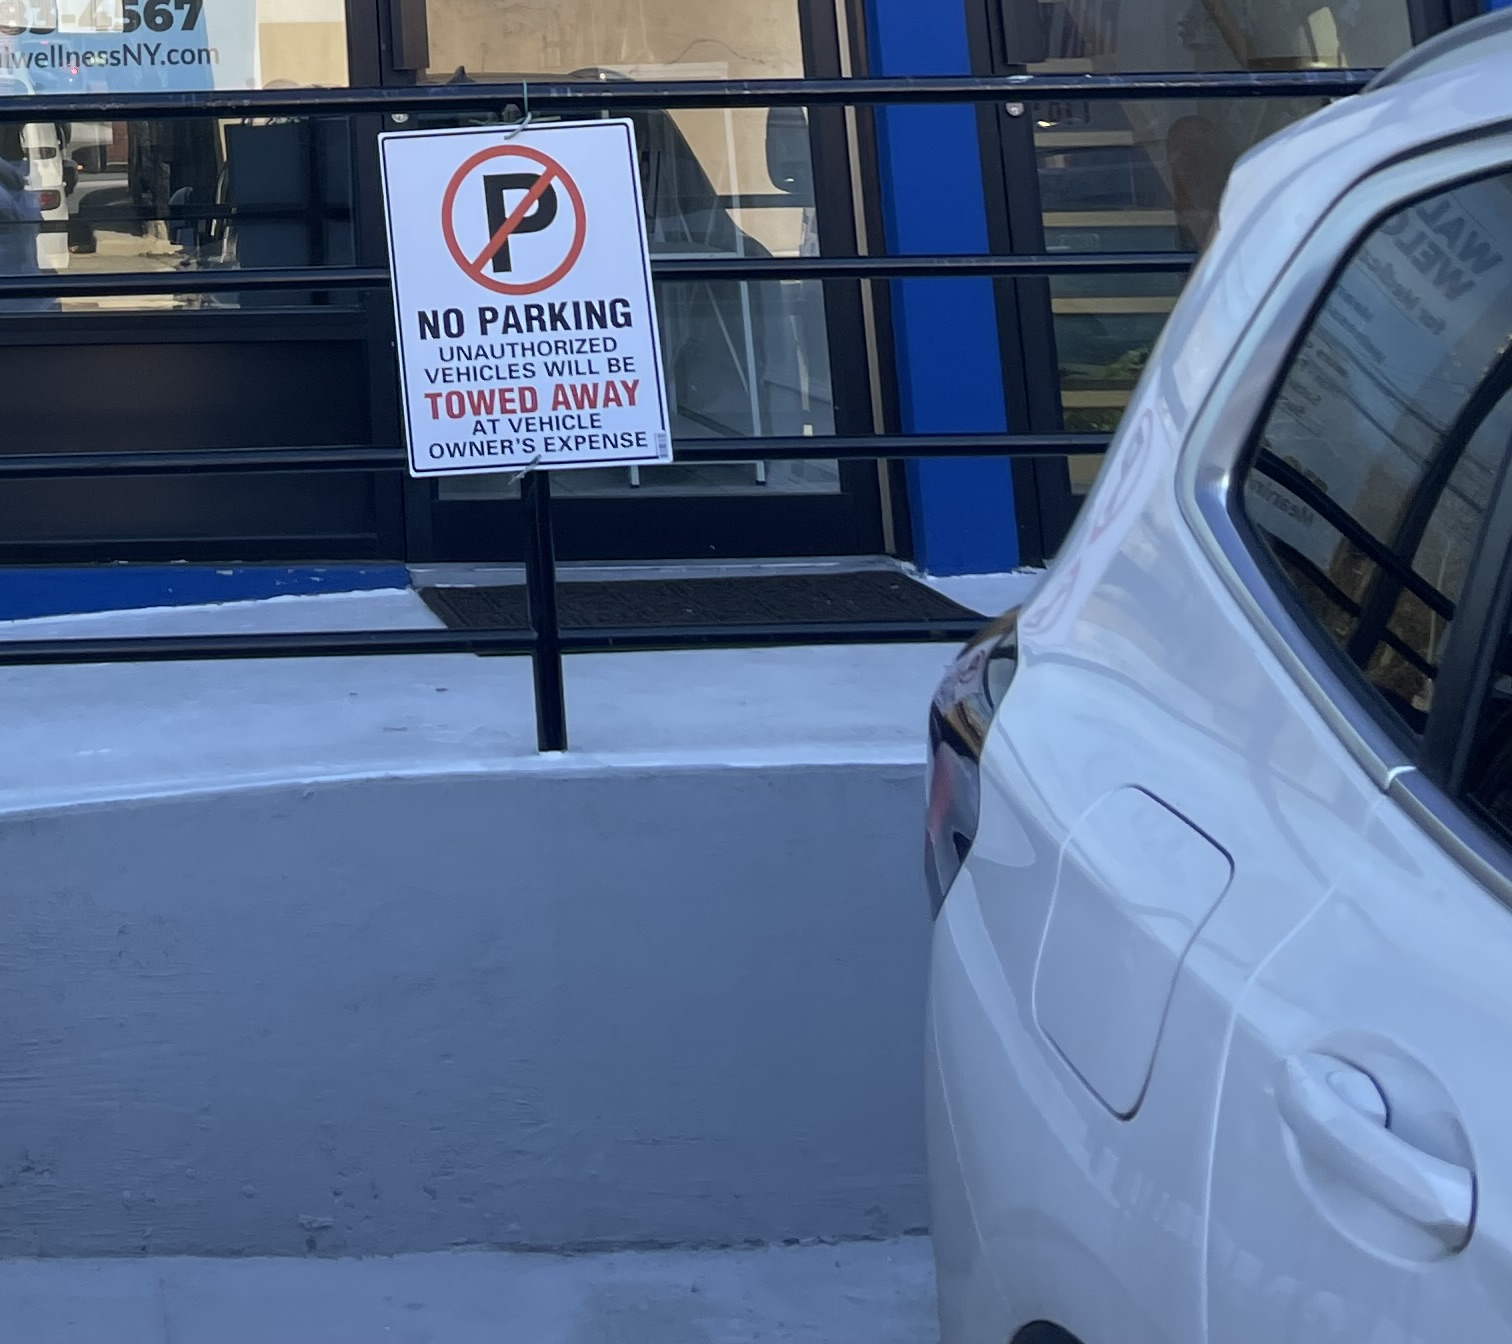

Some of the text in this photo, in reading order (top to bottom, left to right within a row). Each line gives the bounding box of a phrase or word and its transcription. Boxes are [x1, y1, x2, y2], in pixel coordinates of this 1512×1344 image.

[418, 297, 633, 341] NO PARKING
[438, 336, 618, 363] UNAUTHORIZED
[424, 356, 636, 385] VEHICLES WILL BE
[424, 379, 641, 421] TOWED AWAY
[472, 413, 603, 436] AT VEHICLE
[428, 431, 648, 461] OWNER'S EXPENSE
